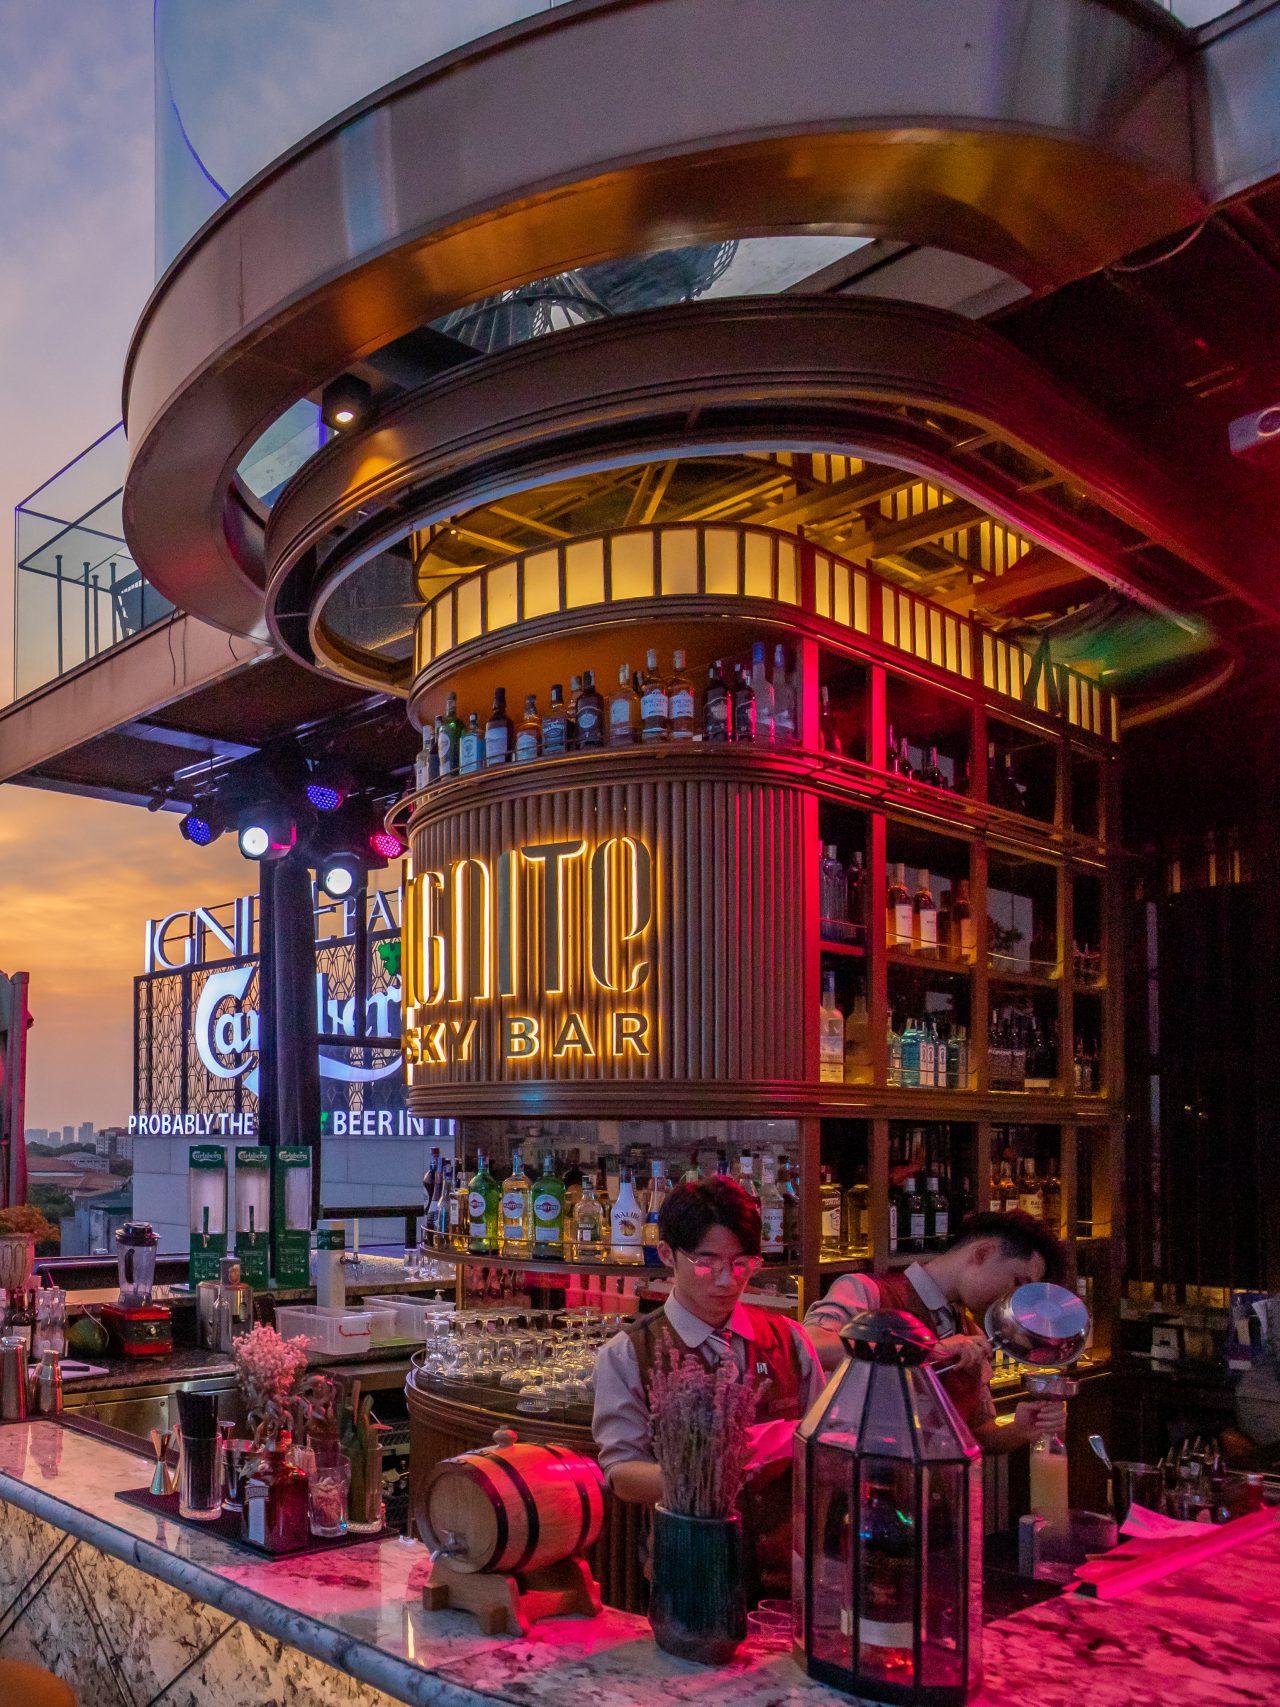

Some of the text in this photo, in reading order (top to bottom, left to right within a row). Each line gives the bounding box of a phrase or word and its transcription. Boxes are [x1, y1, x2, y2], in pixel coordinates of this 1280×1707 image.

[405, 1012, 650, 1066] SKY BAR
[128, 1113, 214, 1135] PROBABLY
[218, 1112, 254, 1135] THE
[333, 1110, 393, 1136] BEER
[192, 1151, 222, 1162] Carlsberg
[238, 1151, 267, 1162] Carlsberg
[279, 1151, 308, 1162] Carlsberg
